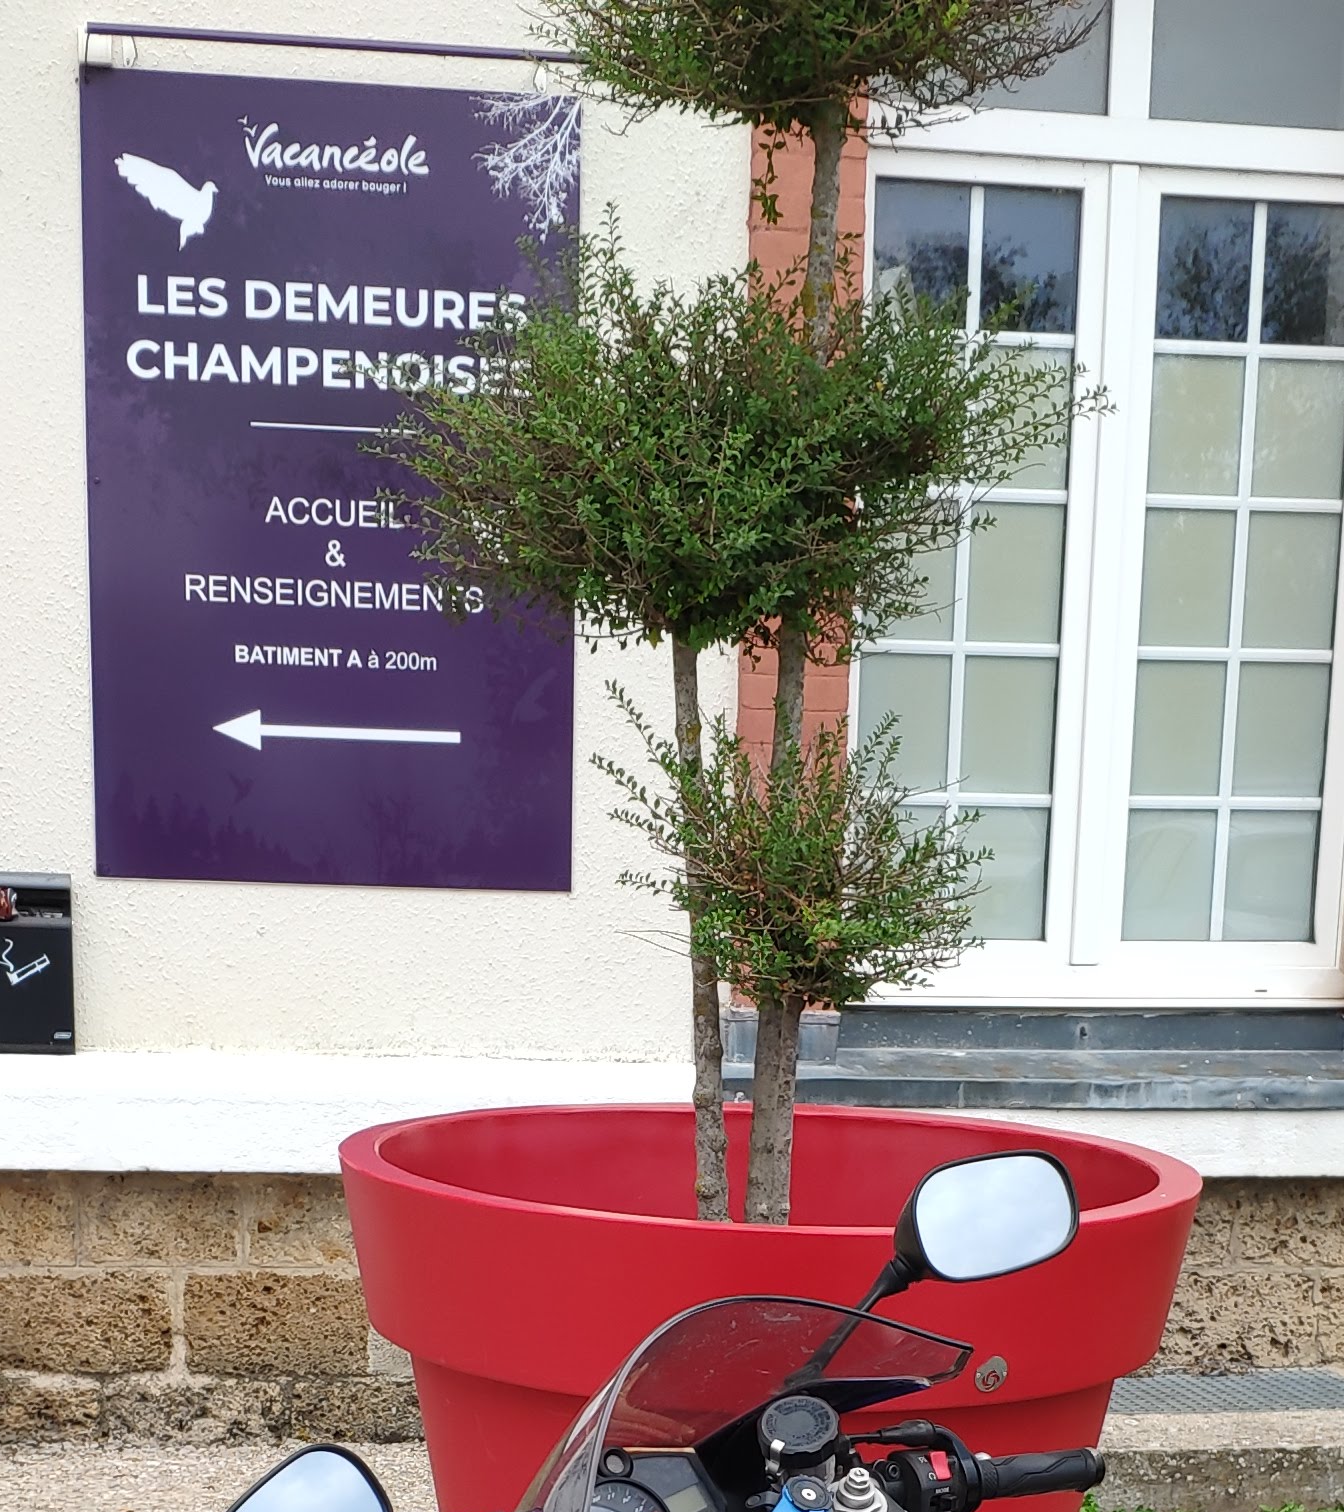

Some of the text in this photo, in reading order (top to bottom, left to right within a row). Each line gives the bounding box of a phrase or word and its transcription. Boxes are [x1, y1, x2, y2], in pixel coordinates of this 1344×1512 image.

[244, 122, 430, 176] Vacancéole
[265, 174, 291, 187] Vous
[294, 176, 320, 189] allez
[323, 178, 359, 191] adorer
[362, 180, 402, 195] bouger
[136, 274, 529, 331] LES DEMEURES
[265, 497, 405, 529] ACCUEIL
[325, 540, 346, 567] &
[234, 645, 437, 671] BATIMENT A à 200m
